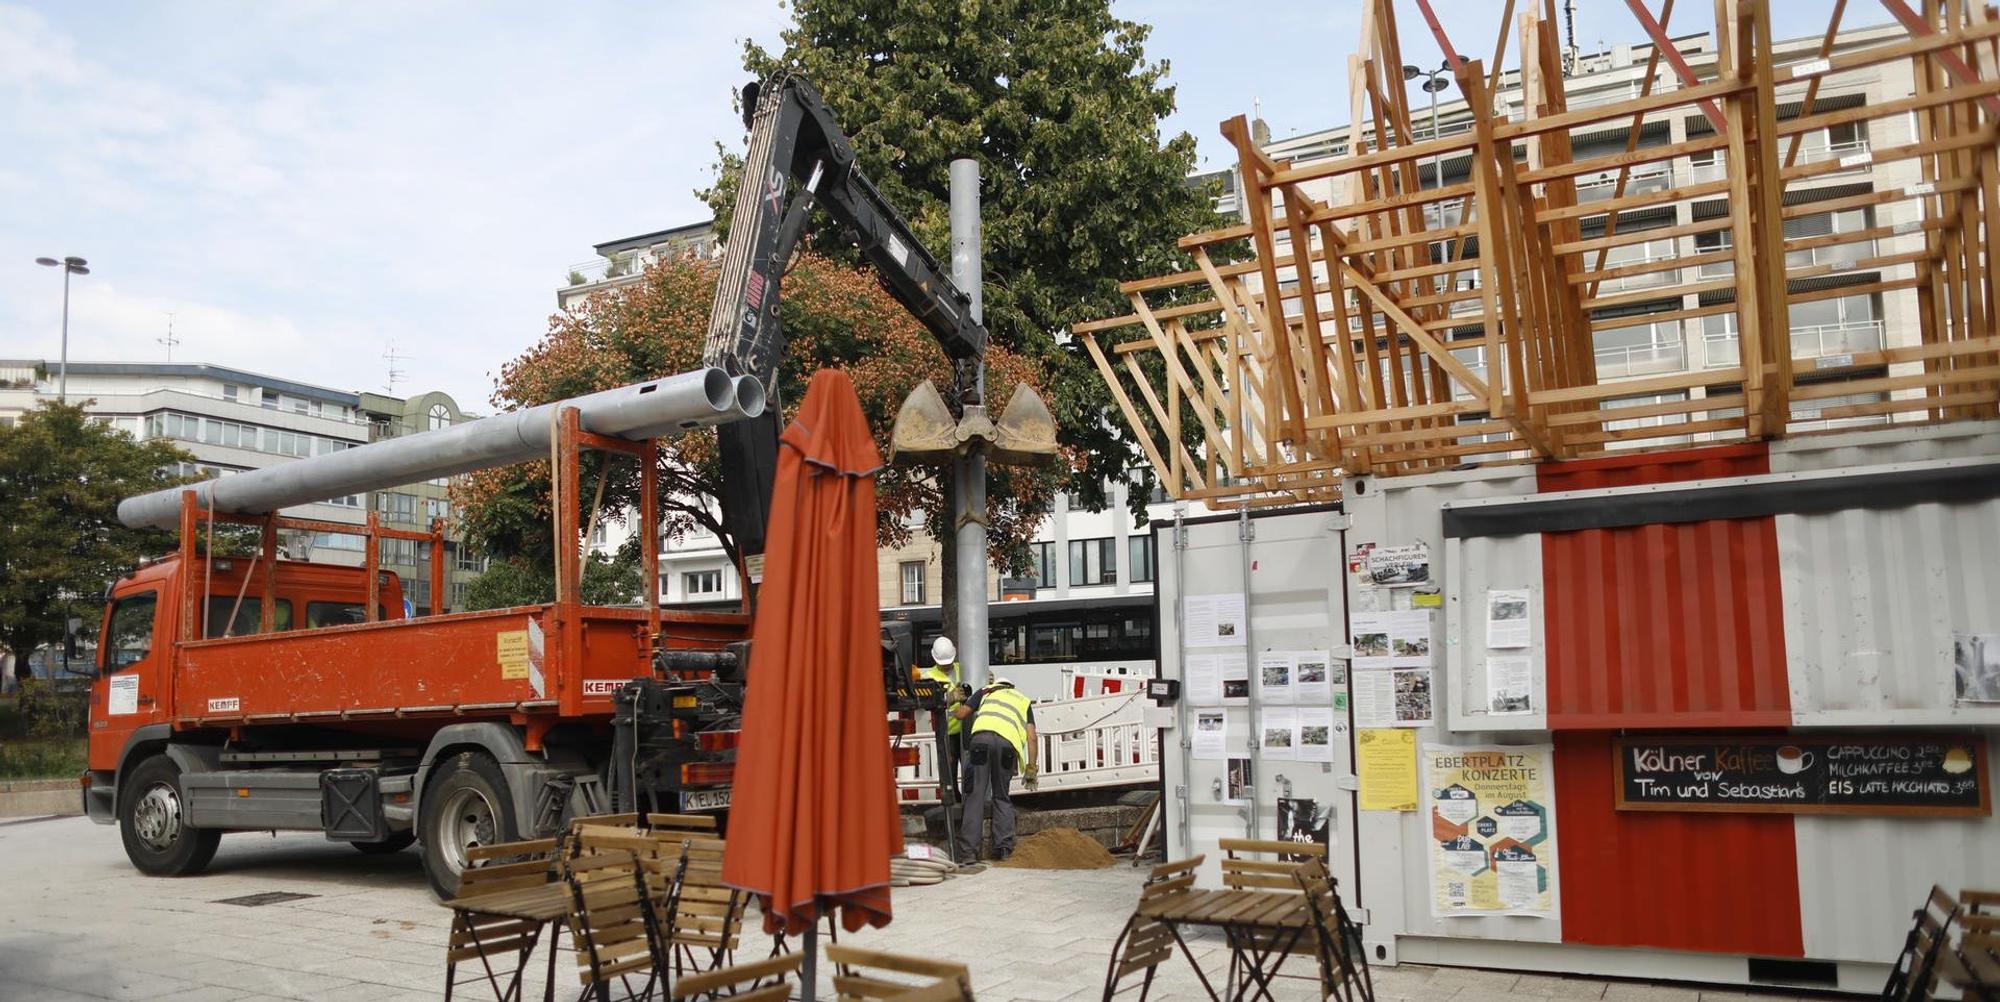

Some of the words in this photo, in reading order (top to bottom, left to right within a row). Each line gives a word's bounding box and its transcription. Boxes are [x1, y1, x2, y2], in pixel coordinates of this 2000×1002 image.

[1371, 553, 1427, 563] SCHACHFIGUREN
[585, 682, 624, 693] KEMP
[209, 700, 239, 710] KEMPF
[1827, 746, 1910, 759] CAPPUCCINO
[1435, 755, 1524, 768] EBERTPLATZ
[1633, 747, 1706, 773] Kölner
[1714, 747, 1775, 774] Kaffee
[1462, 768, 1537, 781] KONZERTE
[1829, 762, 1909, 778] MILCHKAFFEE
[1633, 778, 1671, 797] Tim
[1677, 783, 1708, 798] und
[1717, 781, 1806, 799] Sebastian's
[1829, 780, 1854, 795] EIS
[1859, 781, 1889, 794] LATTE
[1498, 791, 1527, 800] August
[1293, 829, 1314, 844] the
